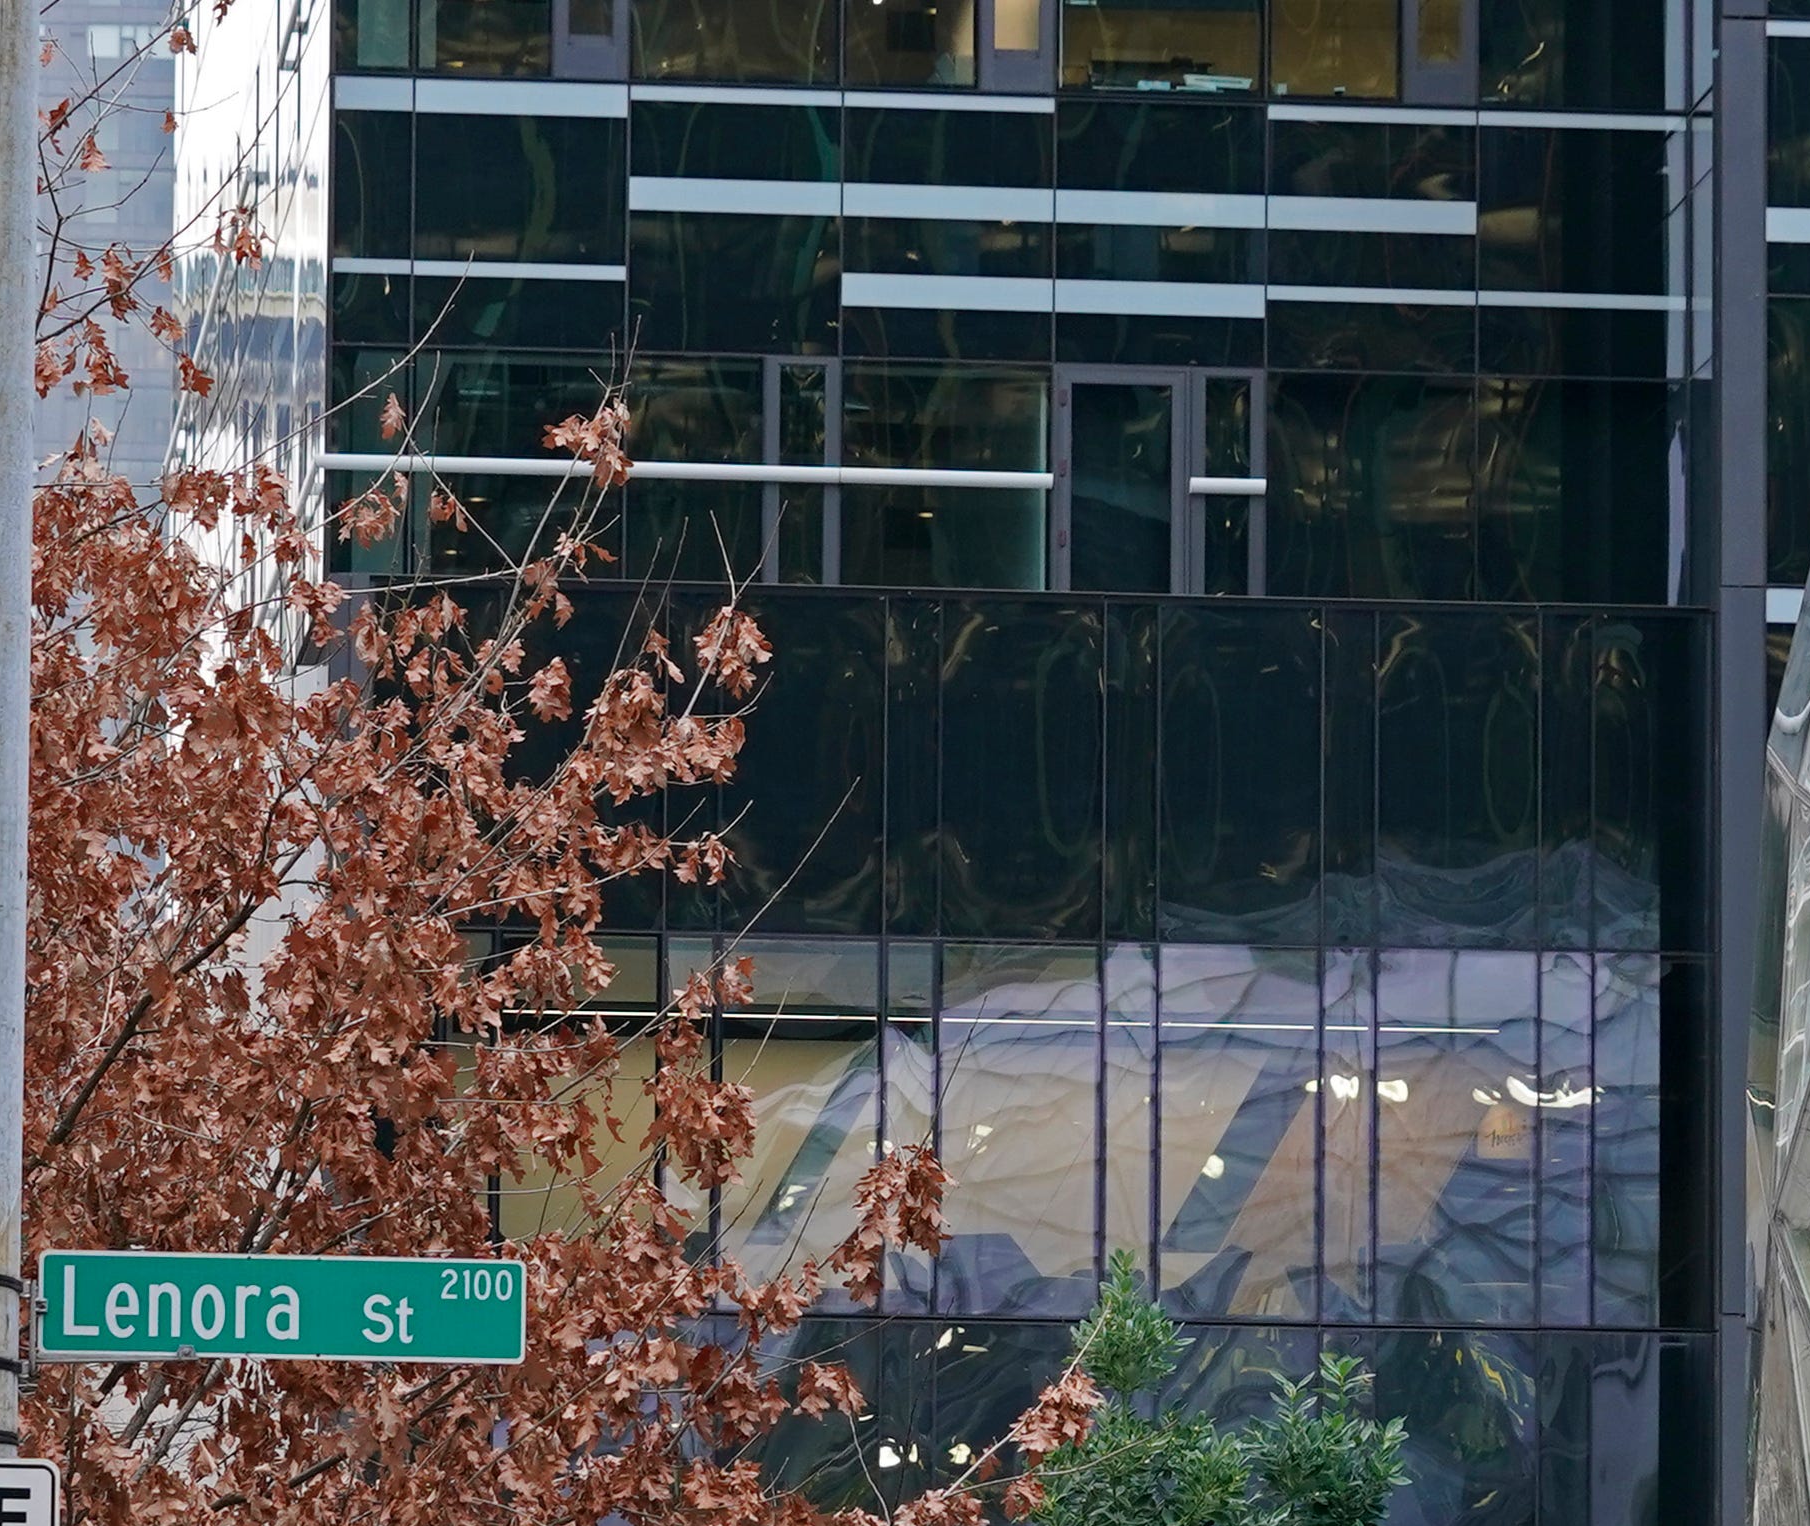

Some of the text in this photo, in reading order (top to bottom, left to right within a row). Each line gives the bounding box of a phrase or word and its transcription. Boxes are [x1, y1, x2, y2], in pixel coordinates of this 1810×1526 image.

[63, 1264, 514, 1344] Lenora St 2100
